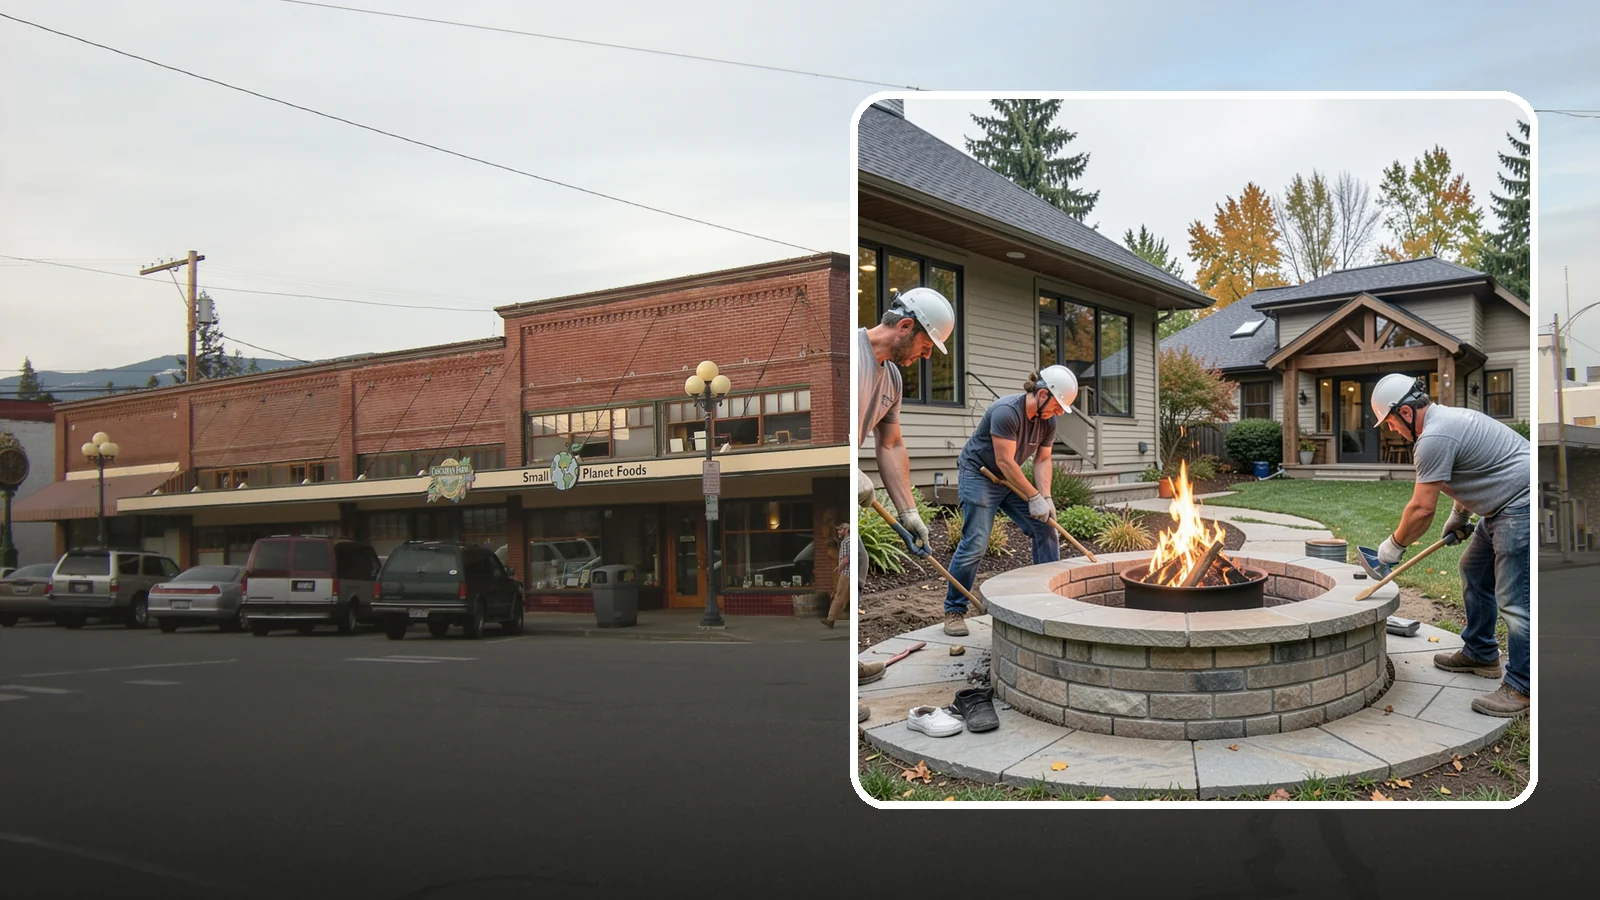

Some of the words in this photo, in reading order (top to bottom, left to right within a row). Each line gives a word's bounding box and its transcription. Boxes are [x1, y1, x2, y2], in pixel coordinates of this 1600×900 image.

[523, 471, 549, 483] Small
[583, 467, 614, 479] Planet
[617, 464, 647, 477] Foods
